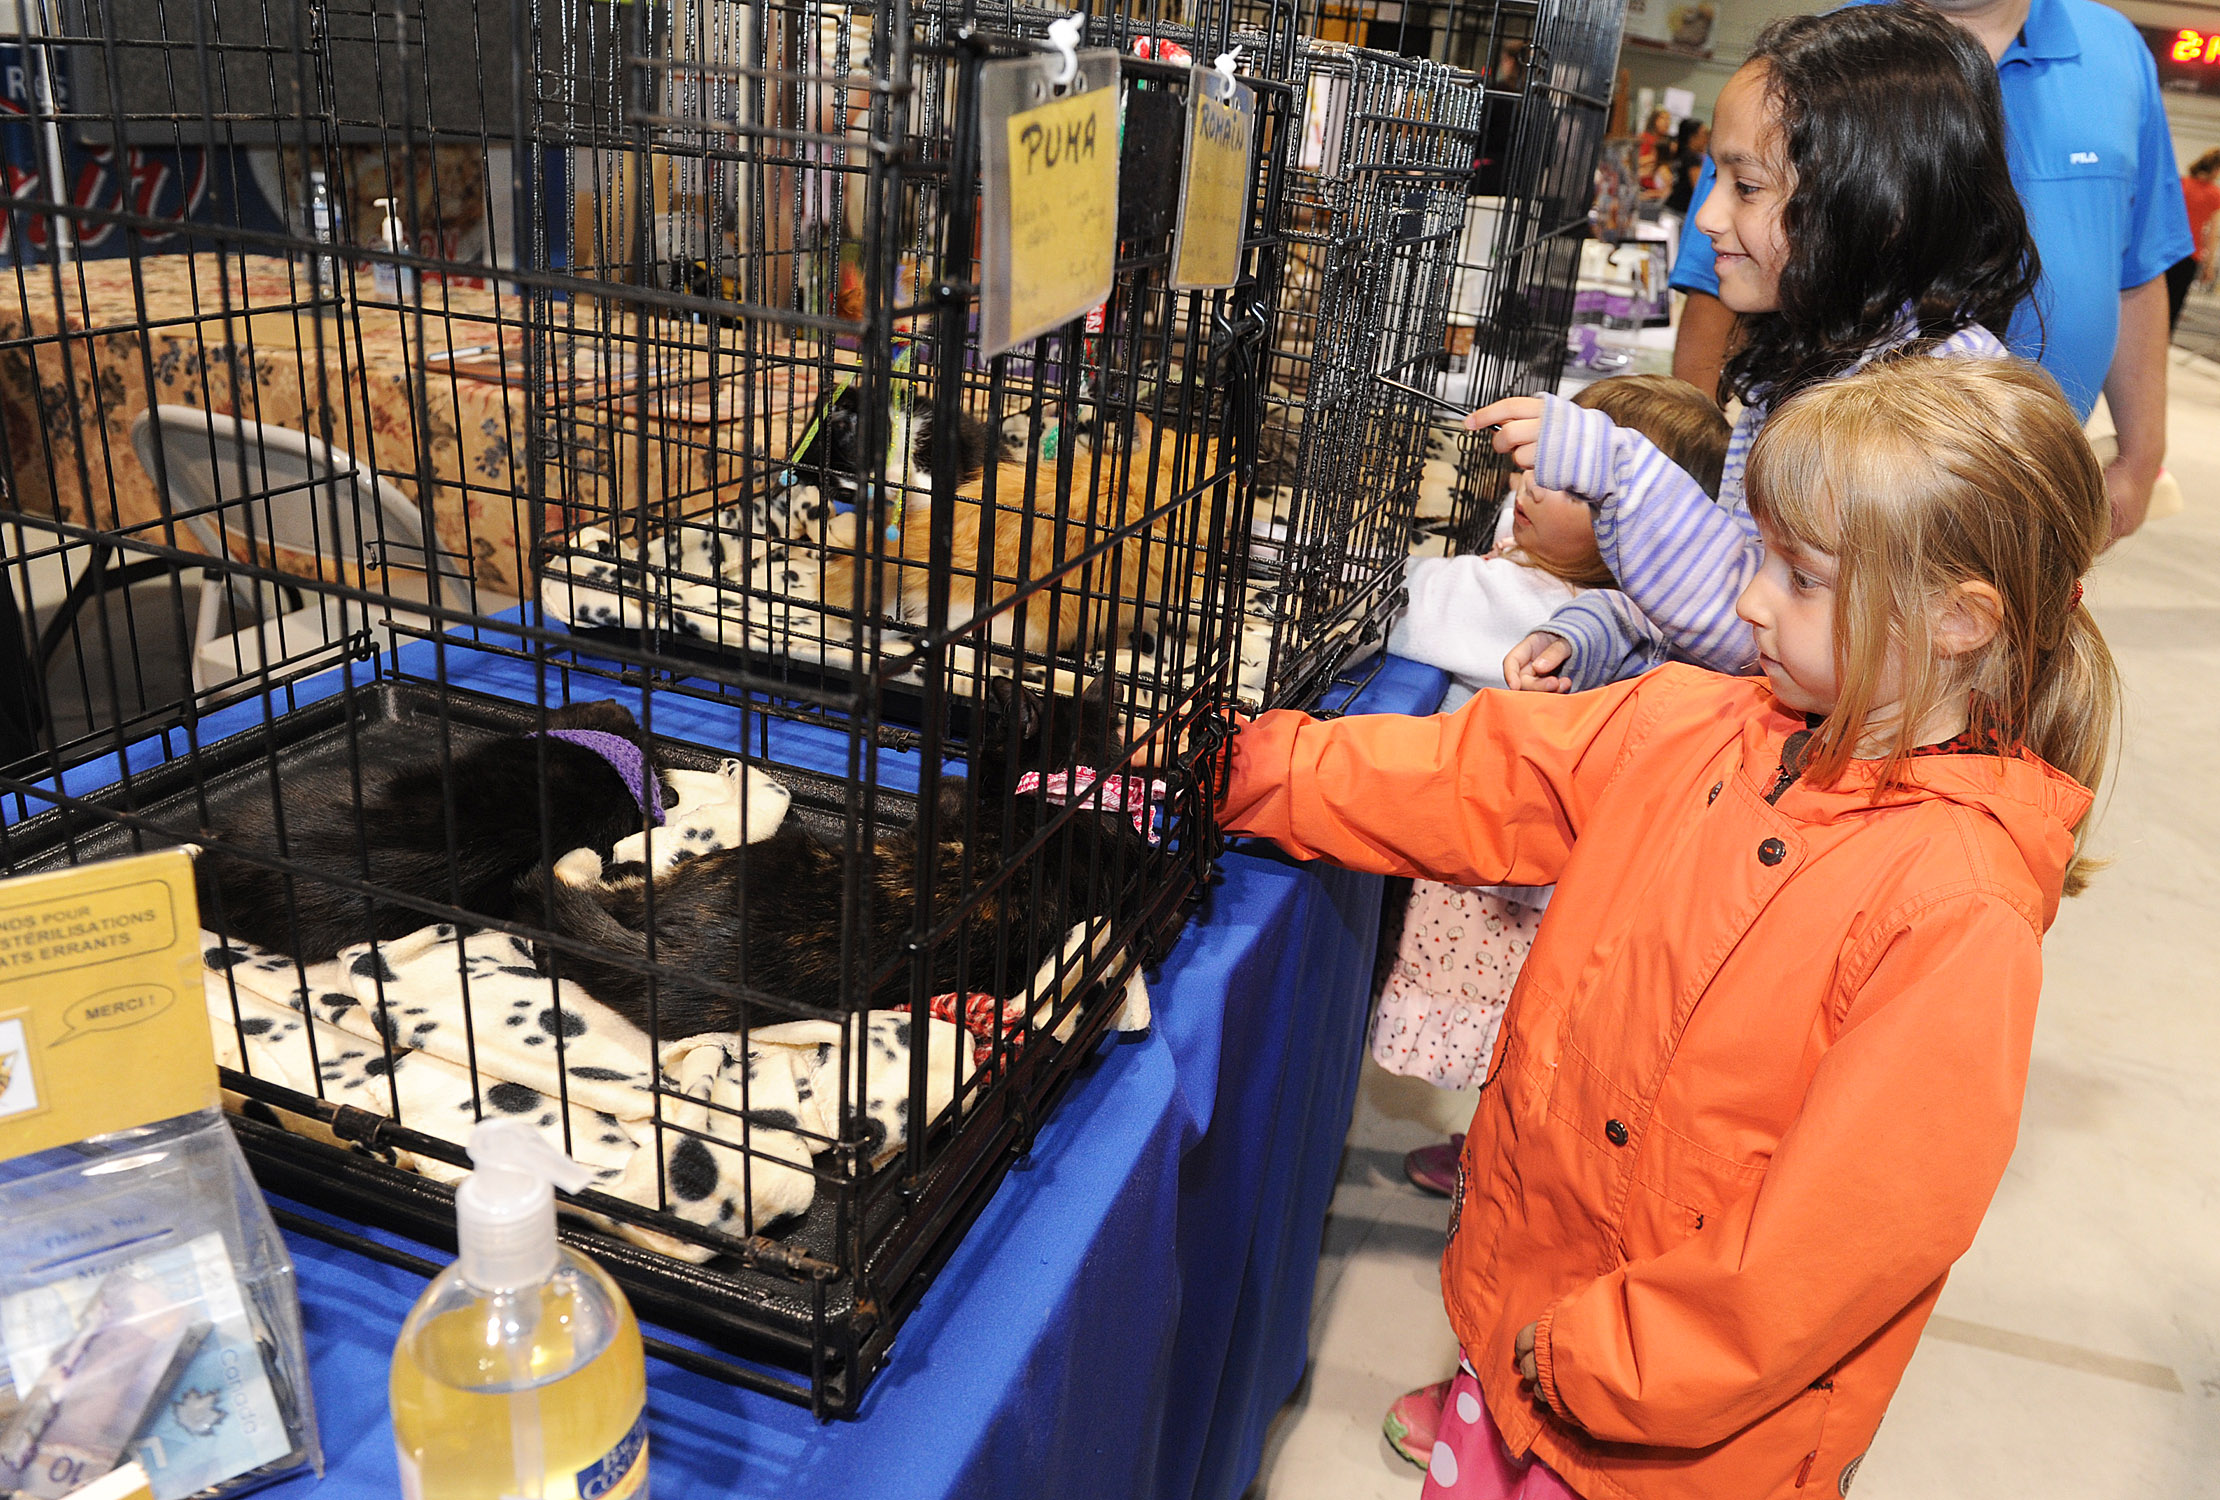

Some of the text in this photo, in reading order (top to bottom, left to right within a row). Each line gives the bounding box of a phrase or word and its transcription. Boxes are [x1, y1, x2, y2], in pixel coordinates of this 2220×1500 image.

[1020, 111, 1097, 175] PUMA
[2069, 151, 2099, 165] FILA
[42, 906, 91, 925] POUR
[40, 932, 132, 960] ERRANTS
[85, 998, 144, 1020] MERCI
